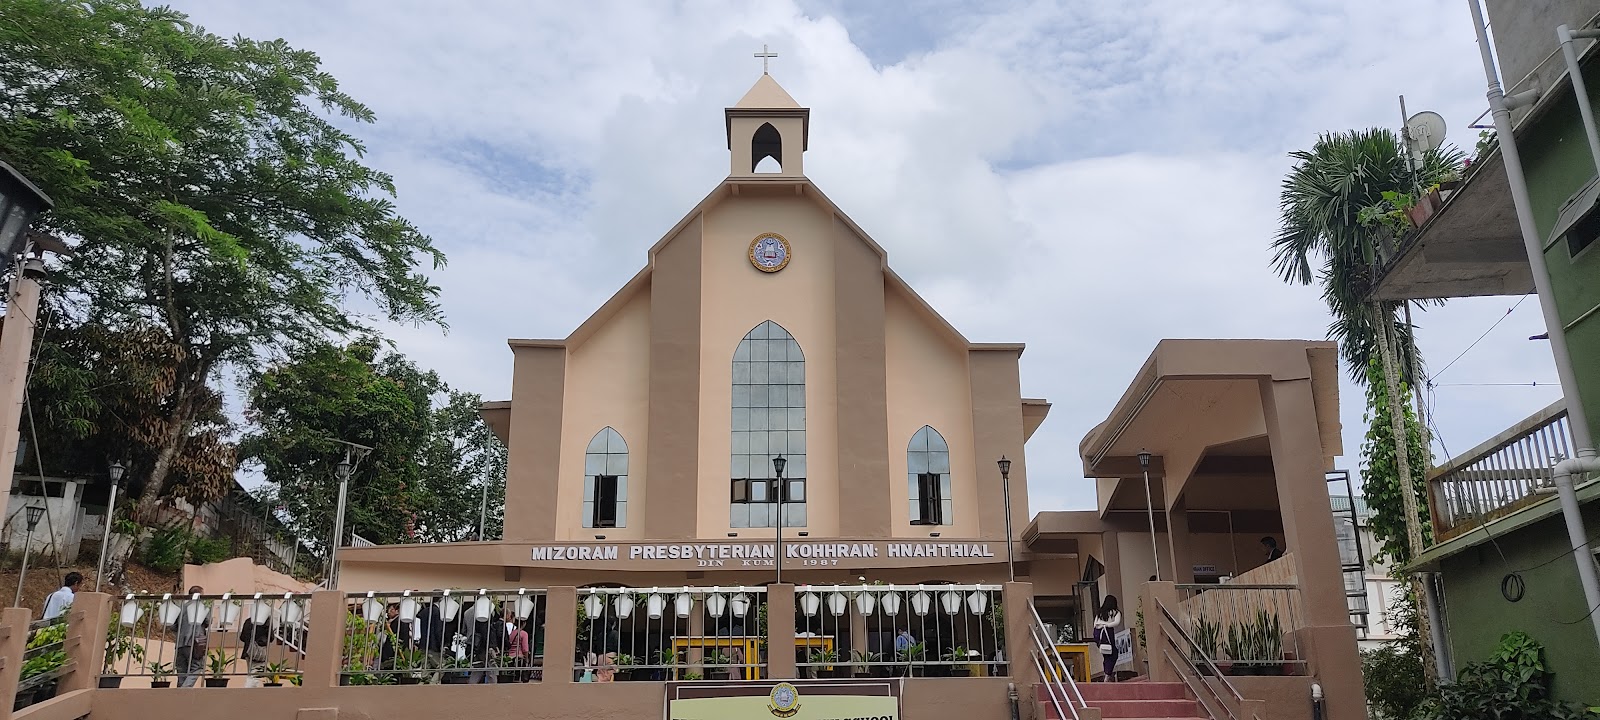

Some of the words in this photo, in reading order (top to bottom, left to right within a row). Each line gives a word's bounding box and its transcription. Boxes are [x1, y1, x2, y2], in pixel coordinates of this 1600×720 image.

[531, 546, 618, 560] MIZORAM
[630, 544, 775, 559] PRESBYTERIAN
[785, 543, 878, 558] KOHHRAN:
[887, 543, 994, 557] HNAHTHIAL
[697, 559, 725, 567] DIN
